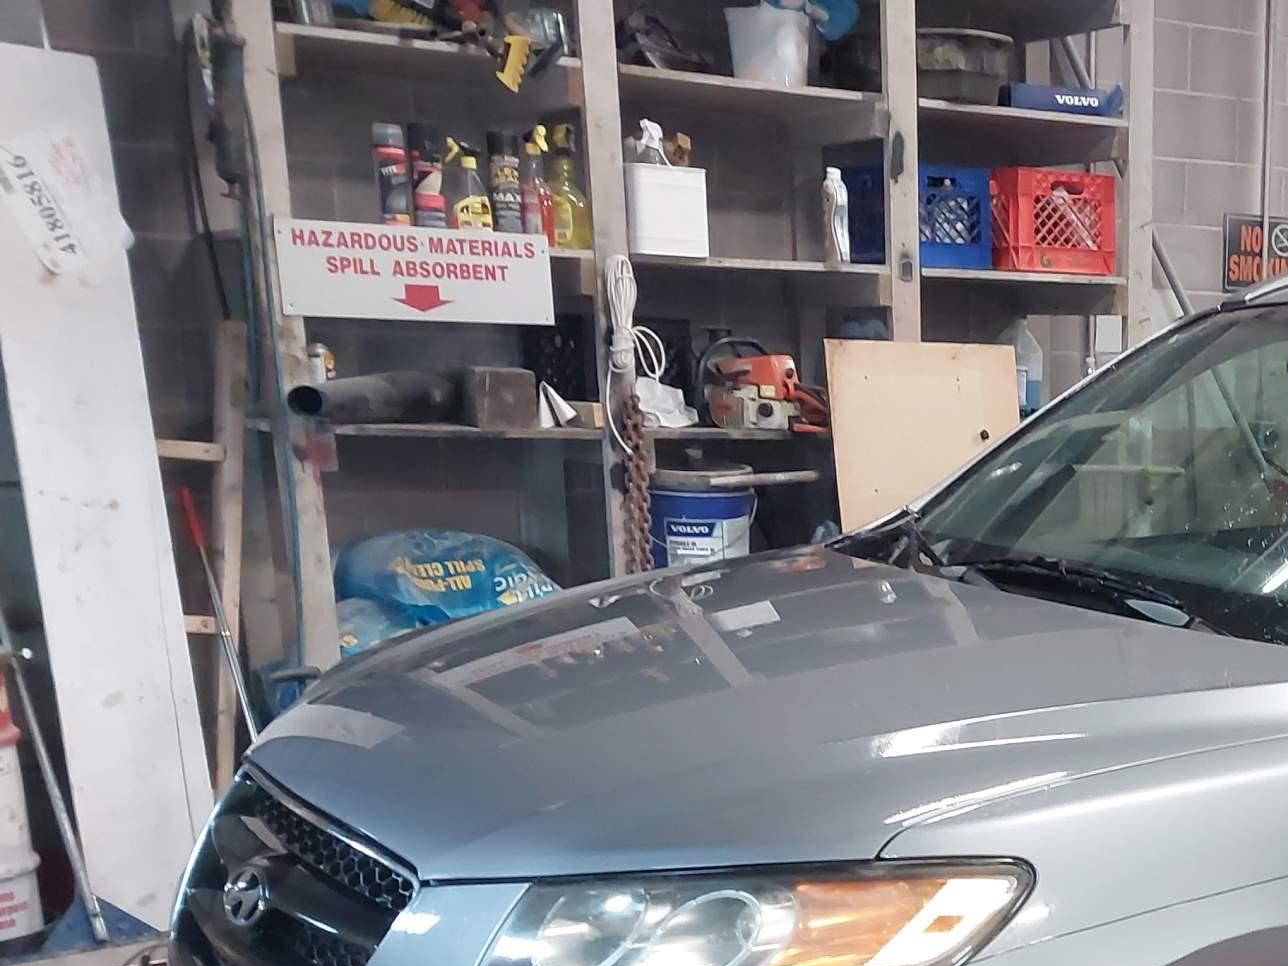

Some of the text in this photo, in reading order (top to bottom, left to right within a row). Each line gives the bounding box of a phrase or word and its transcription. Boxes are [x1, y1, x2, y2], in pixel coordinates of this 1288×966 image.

[1054, 94, 1099, 107] VOLVO
[291, 228, 536, 259] HAZARDOUS MATERIALS
[1240, 223, 1263, 254] NO
[326, 256, 509, 282] SPILL ABSORBENT
[670, 524, 709, 534] VOLVO
